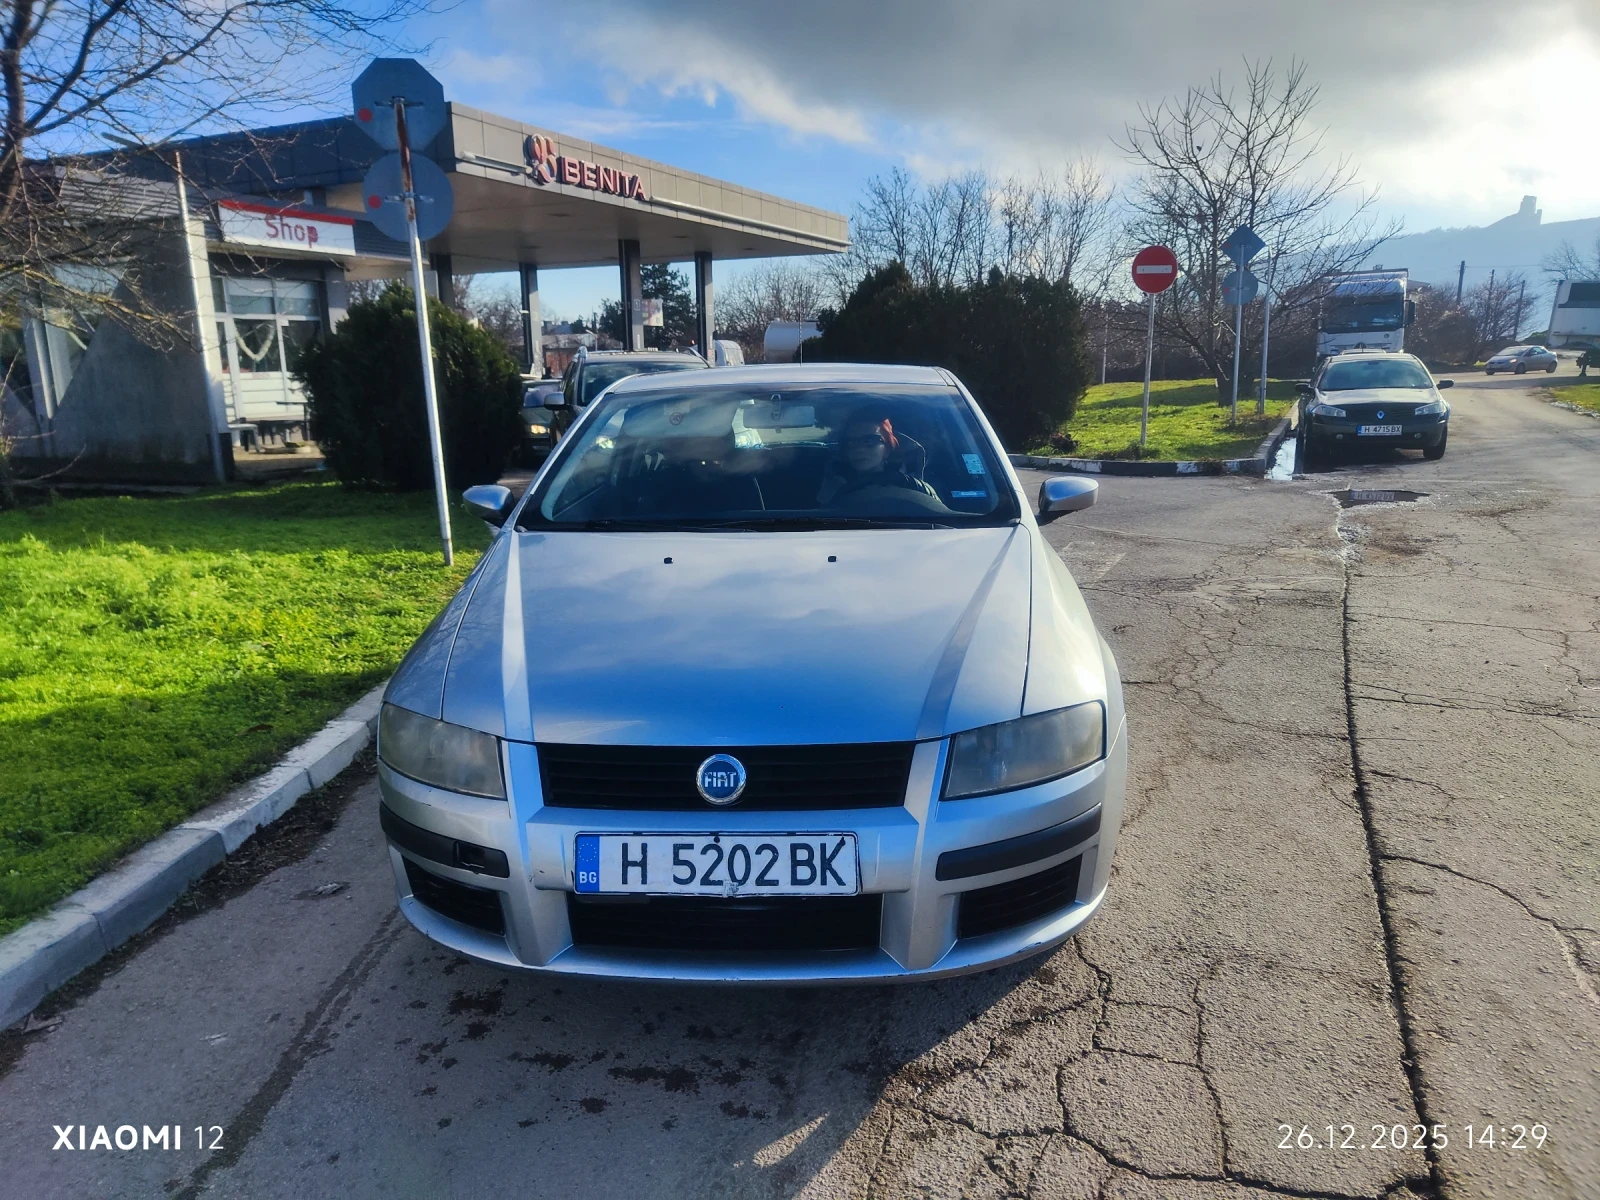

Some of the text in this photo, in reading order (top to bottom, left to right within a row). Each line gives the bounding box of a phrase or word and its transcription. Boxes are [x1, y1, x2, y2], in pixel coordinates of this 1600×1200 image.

[561, 156, 646, 200] BENITA
[264, 213, 318, 248] Shop
[704, 771, 737, 788] FIAT
[579, 871, 597, 884] BG
[621, 842, 648, 885] H
